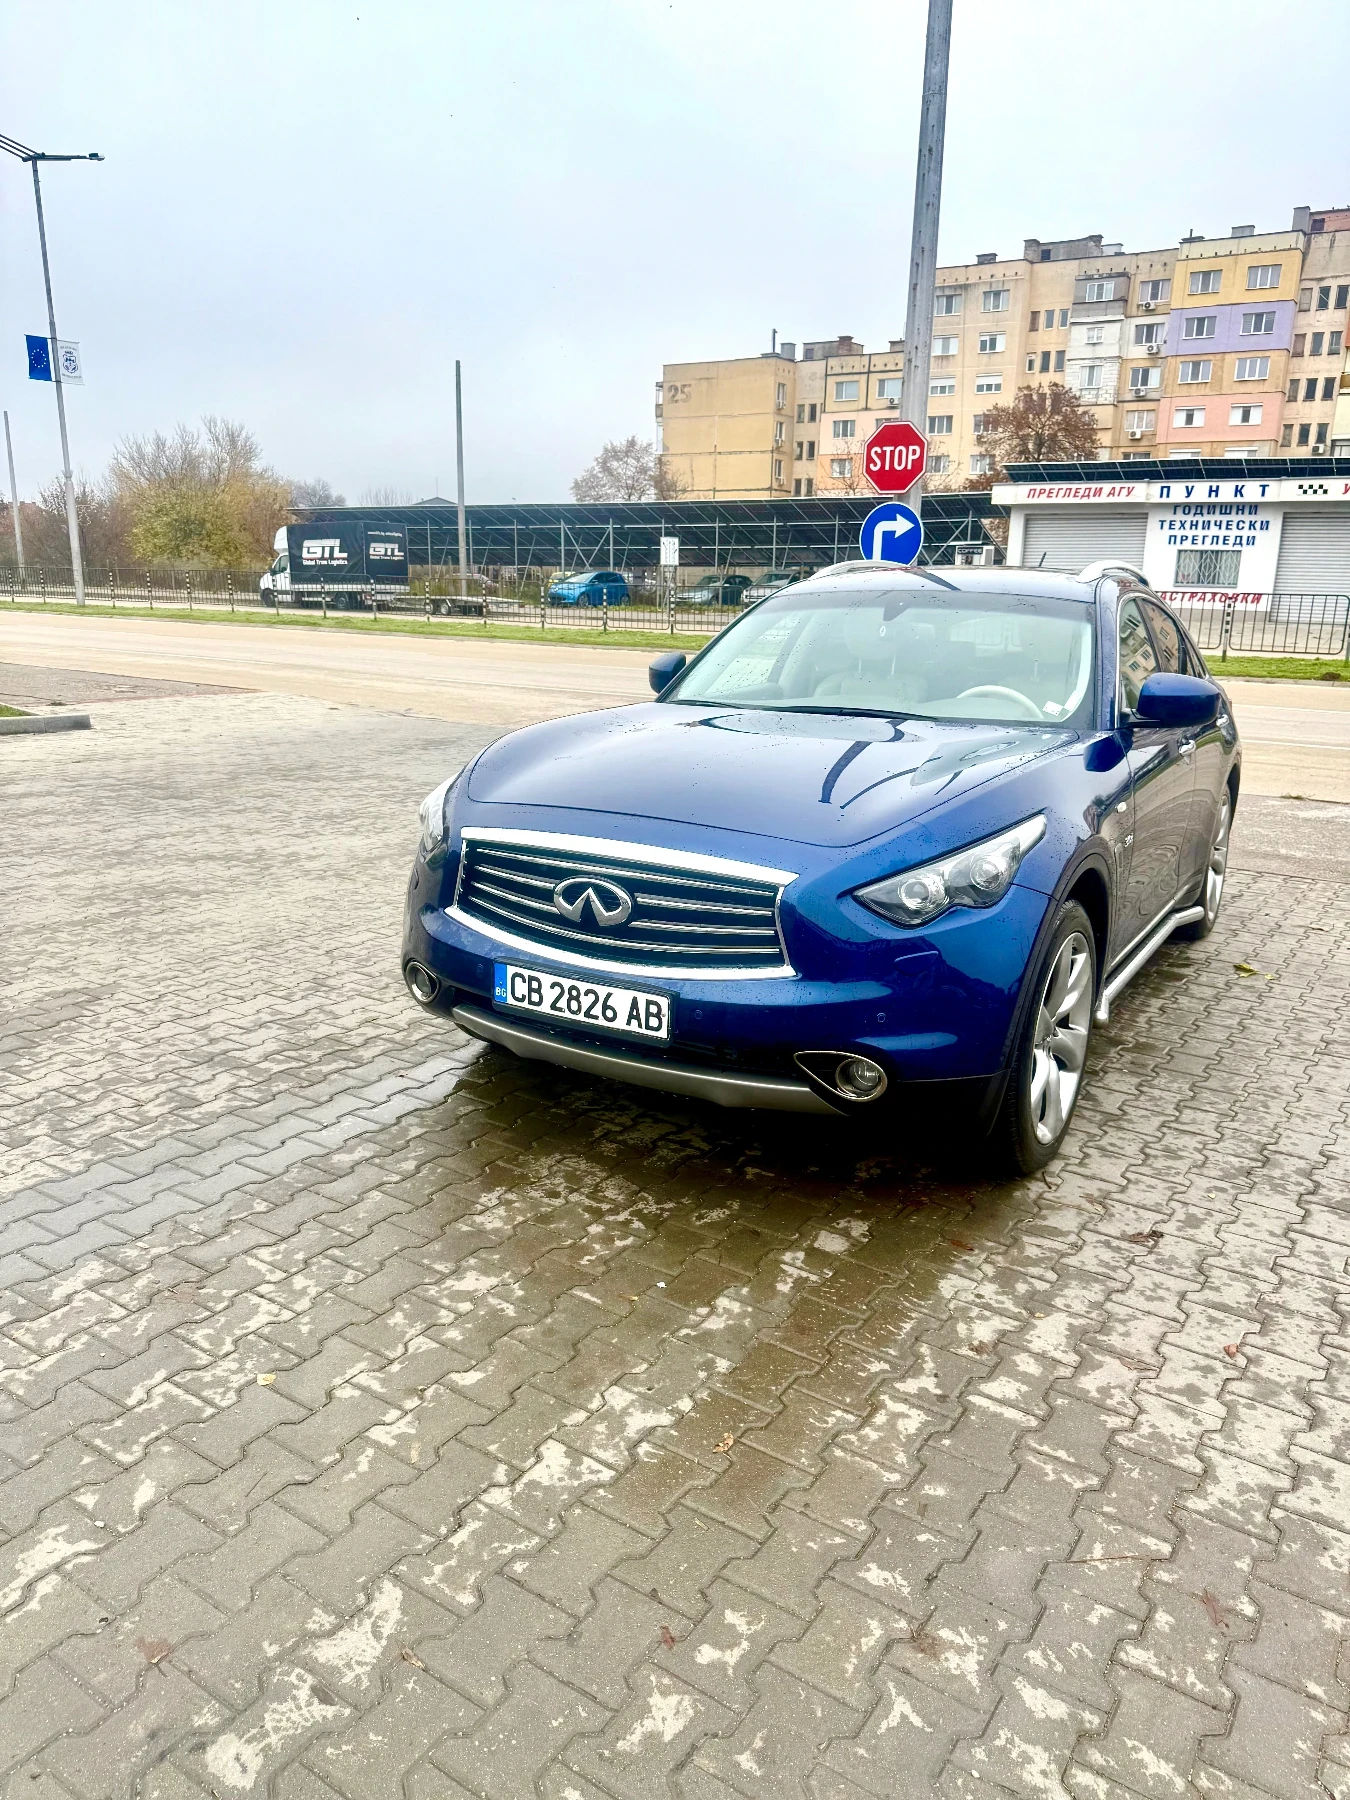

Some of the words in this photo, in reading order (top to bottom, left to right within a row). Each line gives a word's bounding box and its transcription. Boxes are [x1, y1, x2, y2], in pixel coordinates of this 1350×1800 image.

[667, 383, 692, 404] 25
[869, 445, 921, 472] STOP
[1027, 487, 1104, 500] ПРЕГЛЕДИ
[1107, 485, 1136, 498] АГУ
[1159, 484, 1270, 499] ПУНКТ
[1172, 504, 1258, 517] ГОДИШНИ
[1158, 519, 1270, 532] ТЕХНИЧЕСКИ
[1168, 534, 1256, 547] ПРЕГЛЕДИ
[302, 539, 348, 559] GTL
[369, 543, 405, 555] GTL
[1158, 591, 1263, 605] АСТРАХОВКИ
[495, 986, 507, 998] BG
[510, 972, 544, 1007] CB
[549, 981, 618, 1023] 2826
[625, 995, 663, 1032] AB
